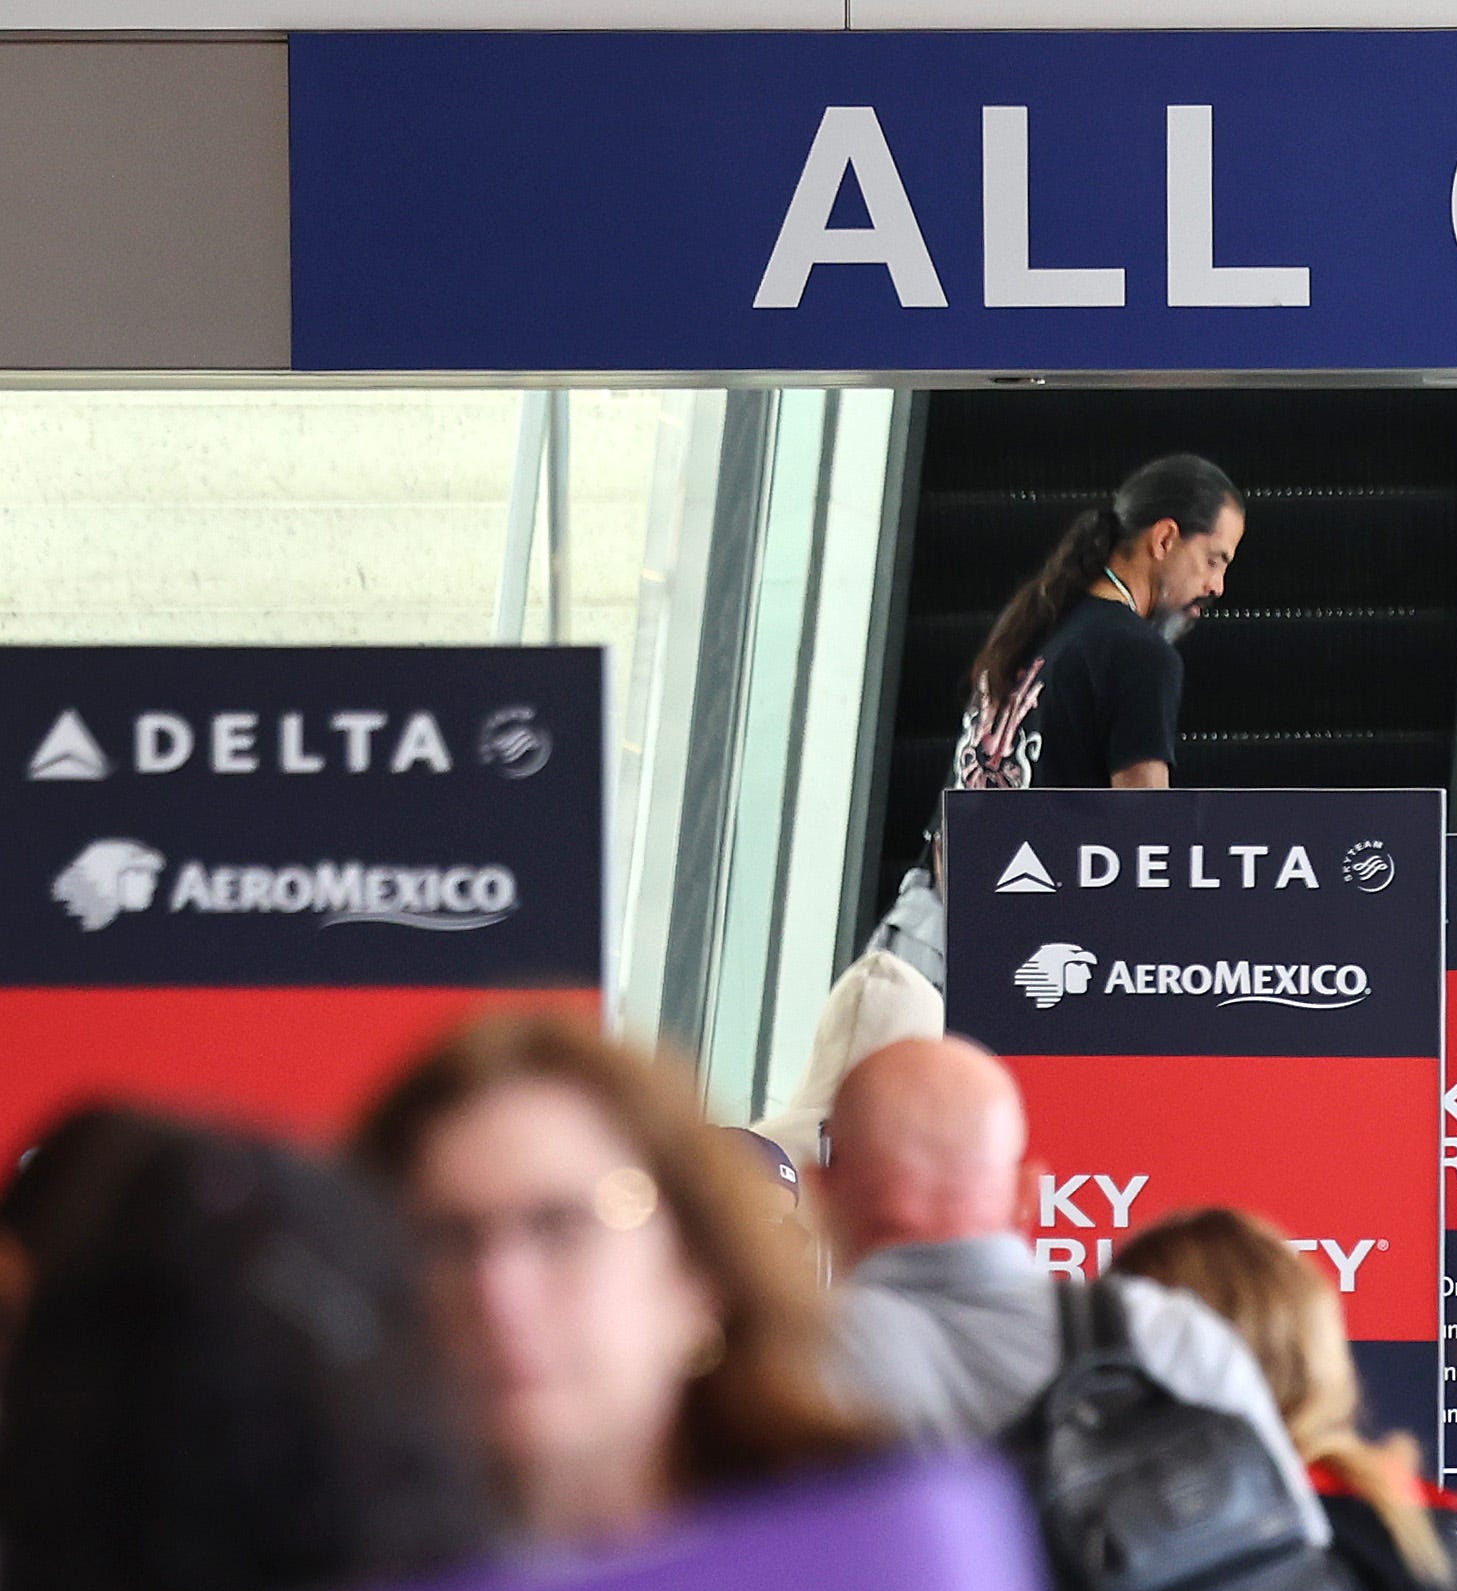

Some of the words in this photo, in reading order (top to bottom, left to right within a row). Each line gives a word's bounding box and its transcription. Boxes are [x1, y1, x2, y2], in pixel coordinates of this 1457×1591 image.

[753, 104, 1310, 309] ALL
[135, 712, 452, 773] DELTA
[1079, 844, 1321, 889] DELTA
[1038, 1174, 1150, 1228] KY
